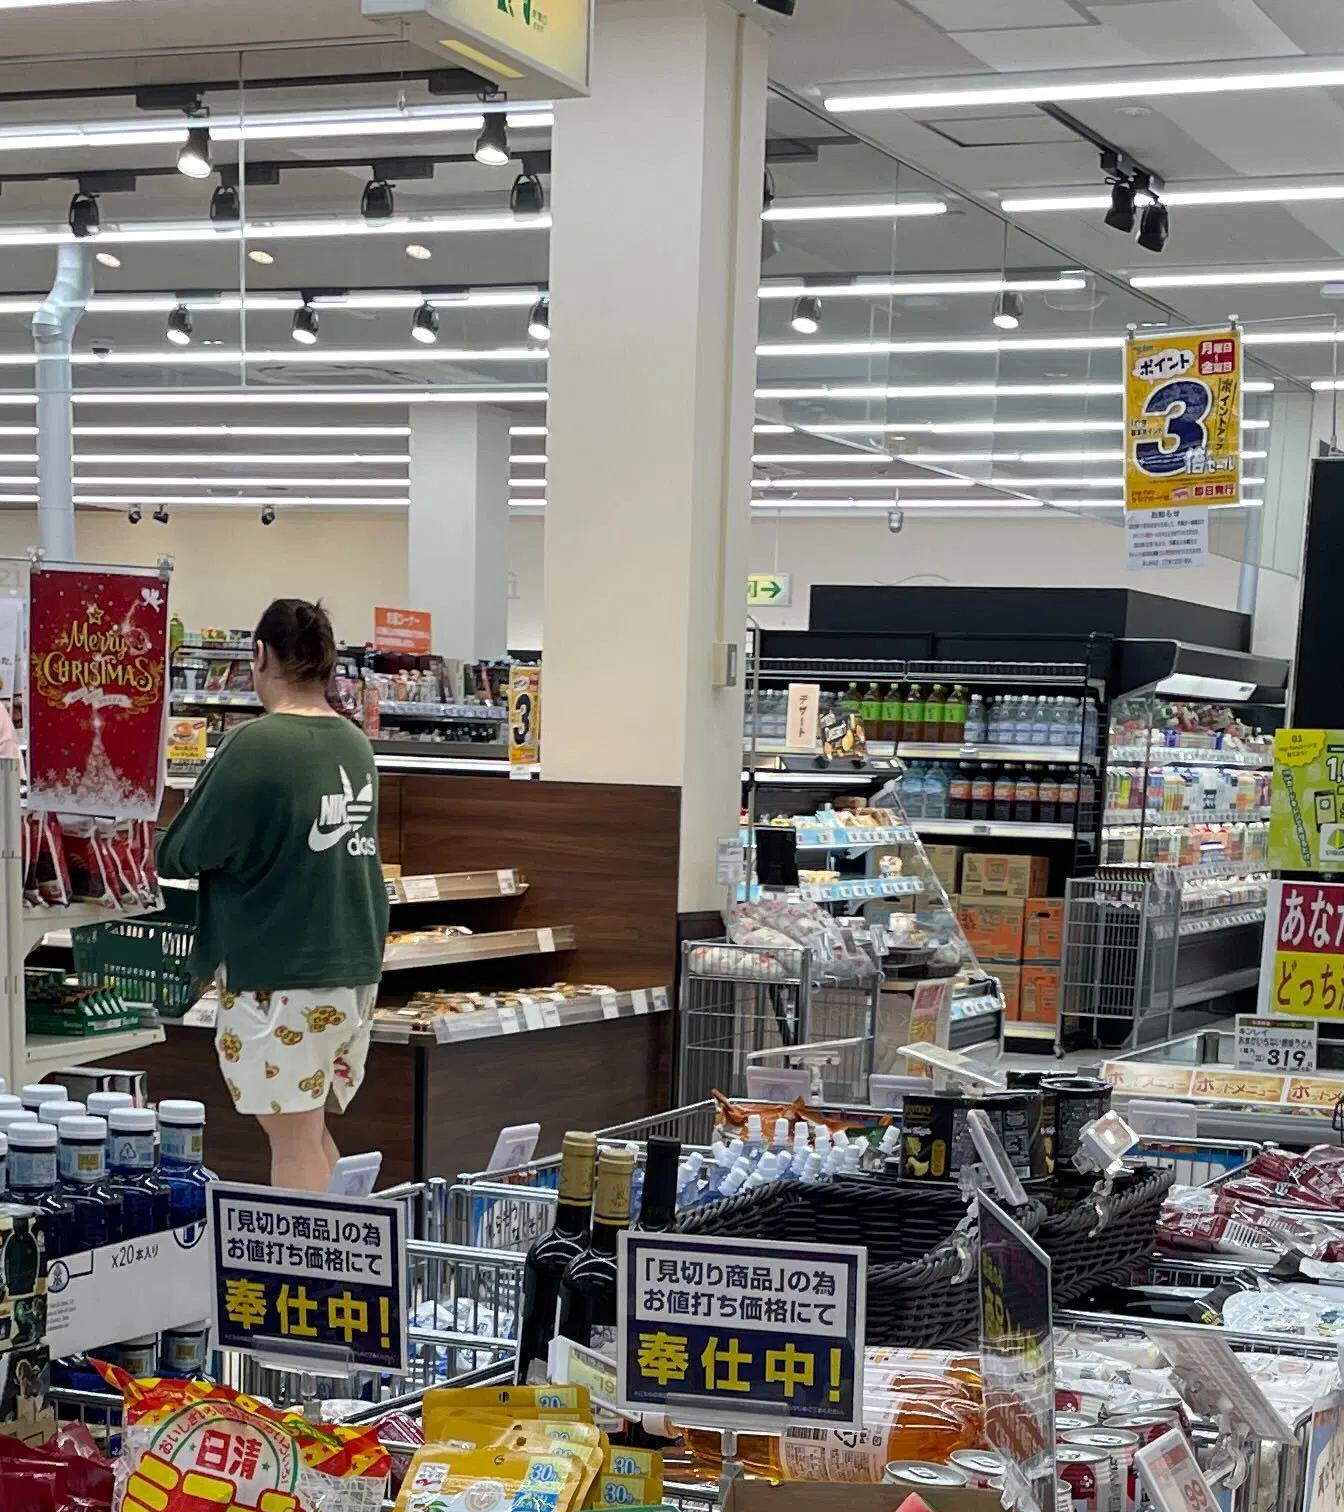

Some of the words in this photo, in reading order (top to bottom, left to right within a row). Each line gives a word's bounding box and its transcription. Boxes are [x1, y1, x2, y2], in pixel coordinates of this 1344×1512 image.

[1139, 352, 1190, 377] ポイント
[67, 620, 130, 661] Merry
[43, 651, 153, 692] CHRISTMAS
[798, 694, 809, 738] デザート
[1266, 1048, 1306, 1068] 319
[222, 1204, 384, 1249] 「見切り商品」の為
[226, 1237, 384, 1277] お値打ち価格にて
[644, 1254, 837, 1299] 「見切り商品」の為
[225, 1278, 393, 1350] 奉仕中!
[643, 1288, 837, 1327] お値打ち価格にて
[636, 1331, 843, 1403] 奉仕中!
[195, 1428, 264, 1481] 日清
